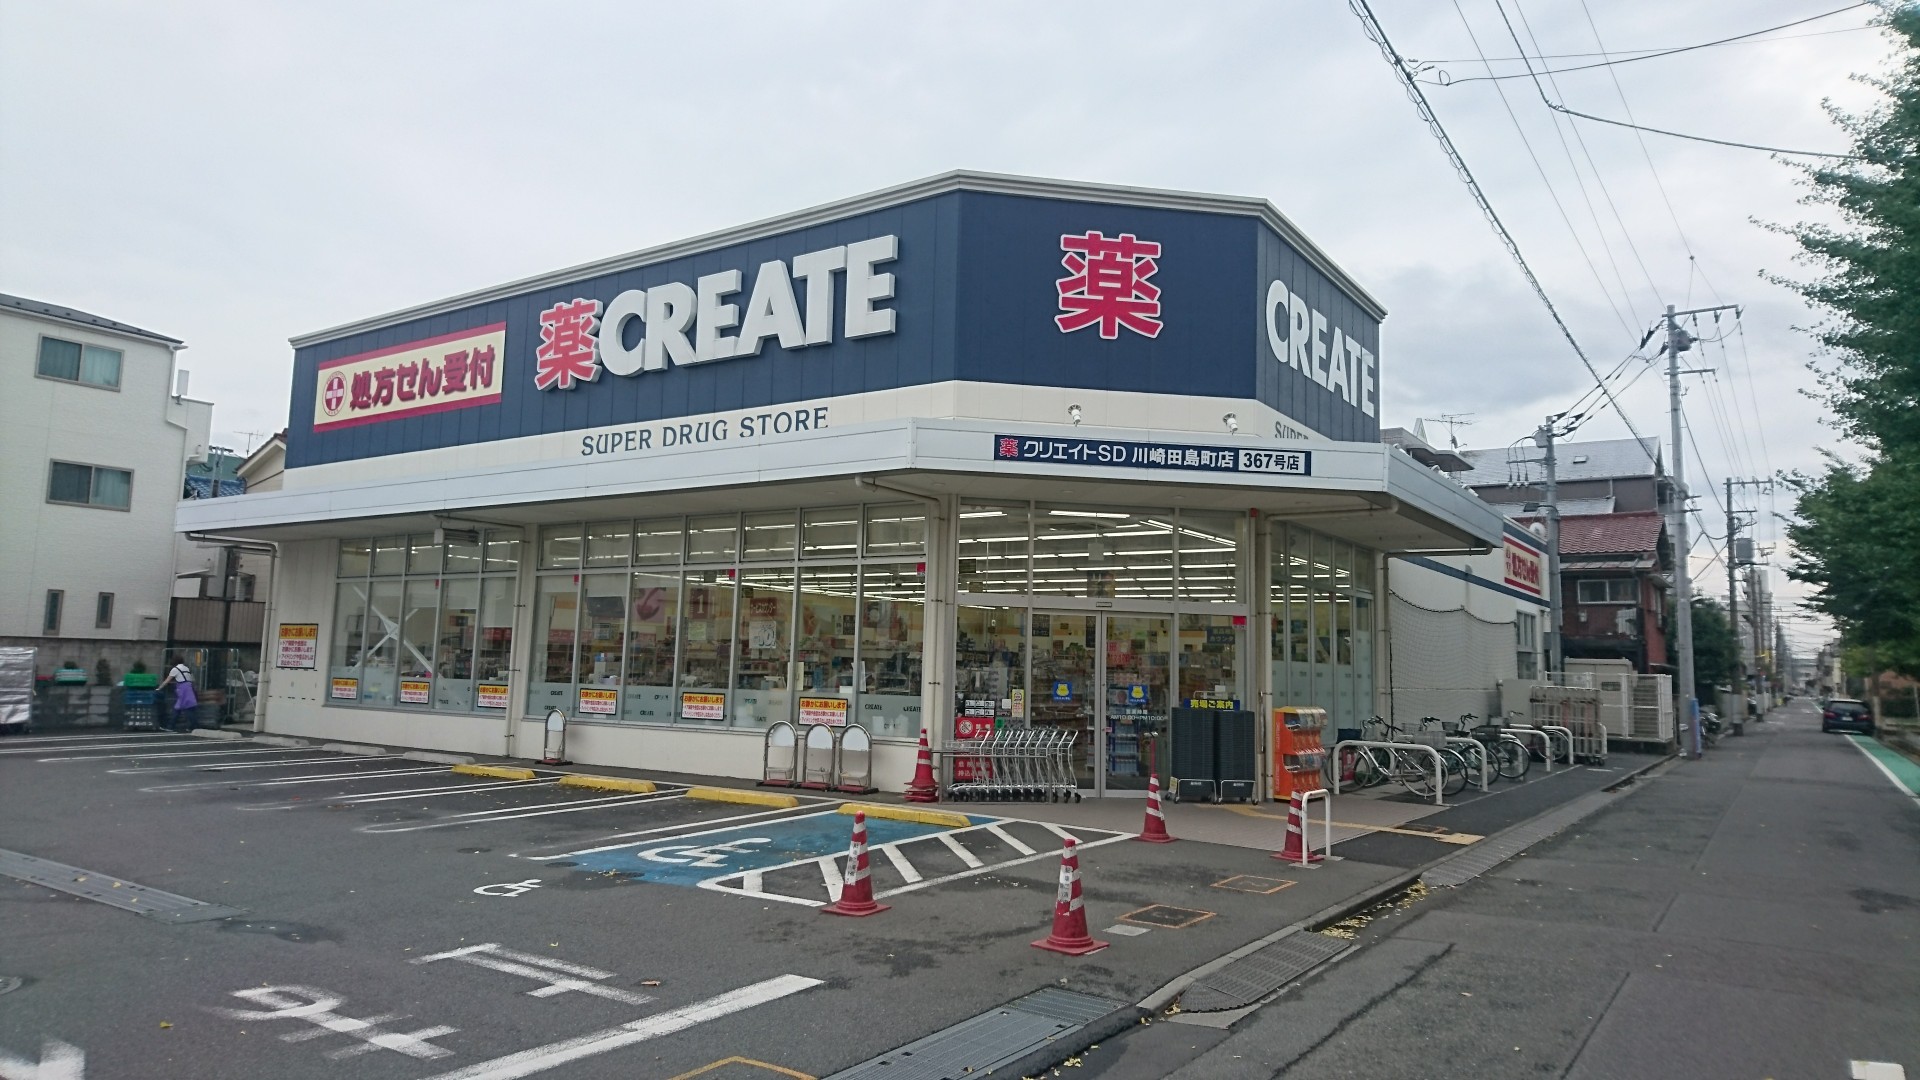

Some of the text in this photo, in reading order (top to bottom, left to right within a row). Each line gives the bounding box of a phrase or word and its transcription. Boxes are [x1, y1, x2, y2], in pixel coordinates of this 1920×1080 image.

[535, 235, 899, 391] 薬 CREATE
[1054, 231, 1163, 339] 薬
[350, 344, 496, 411] 処方せん受付
[1266, 280, 1375, 418] CREATE
[581, 407, 829, 456] SUPER DRUG STORE
[999, 438, 1300, 471] 薬 クリエイトSD 川崎田島町店 367号店
[1190, 699, 1234, 709] 売場ご案内
